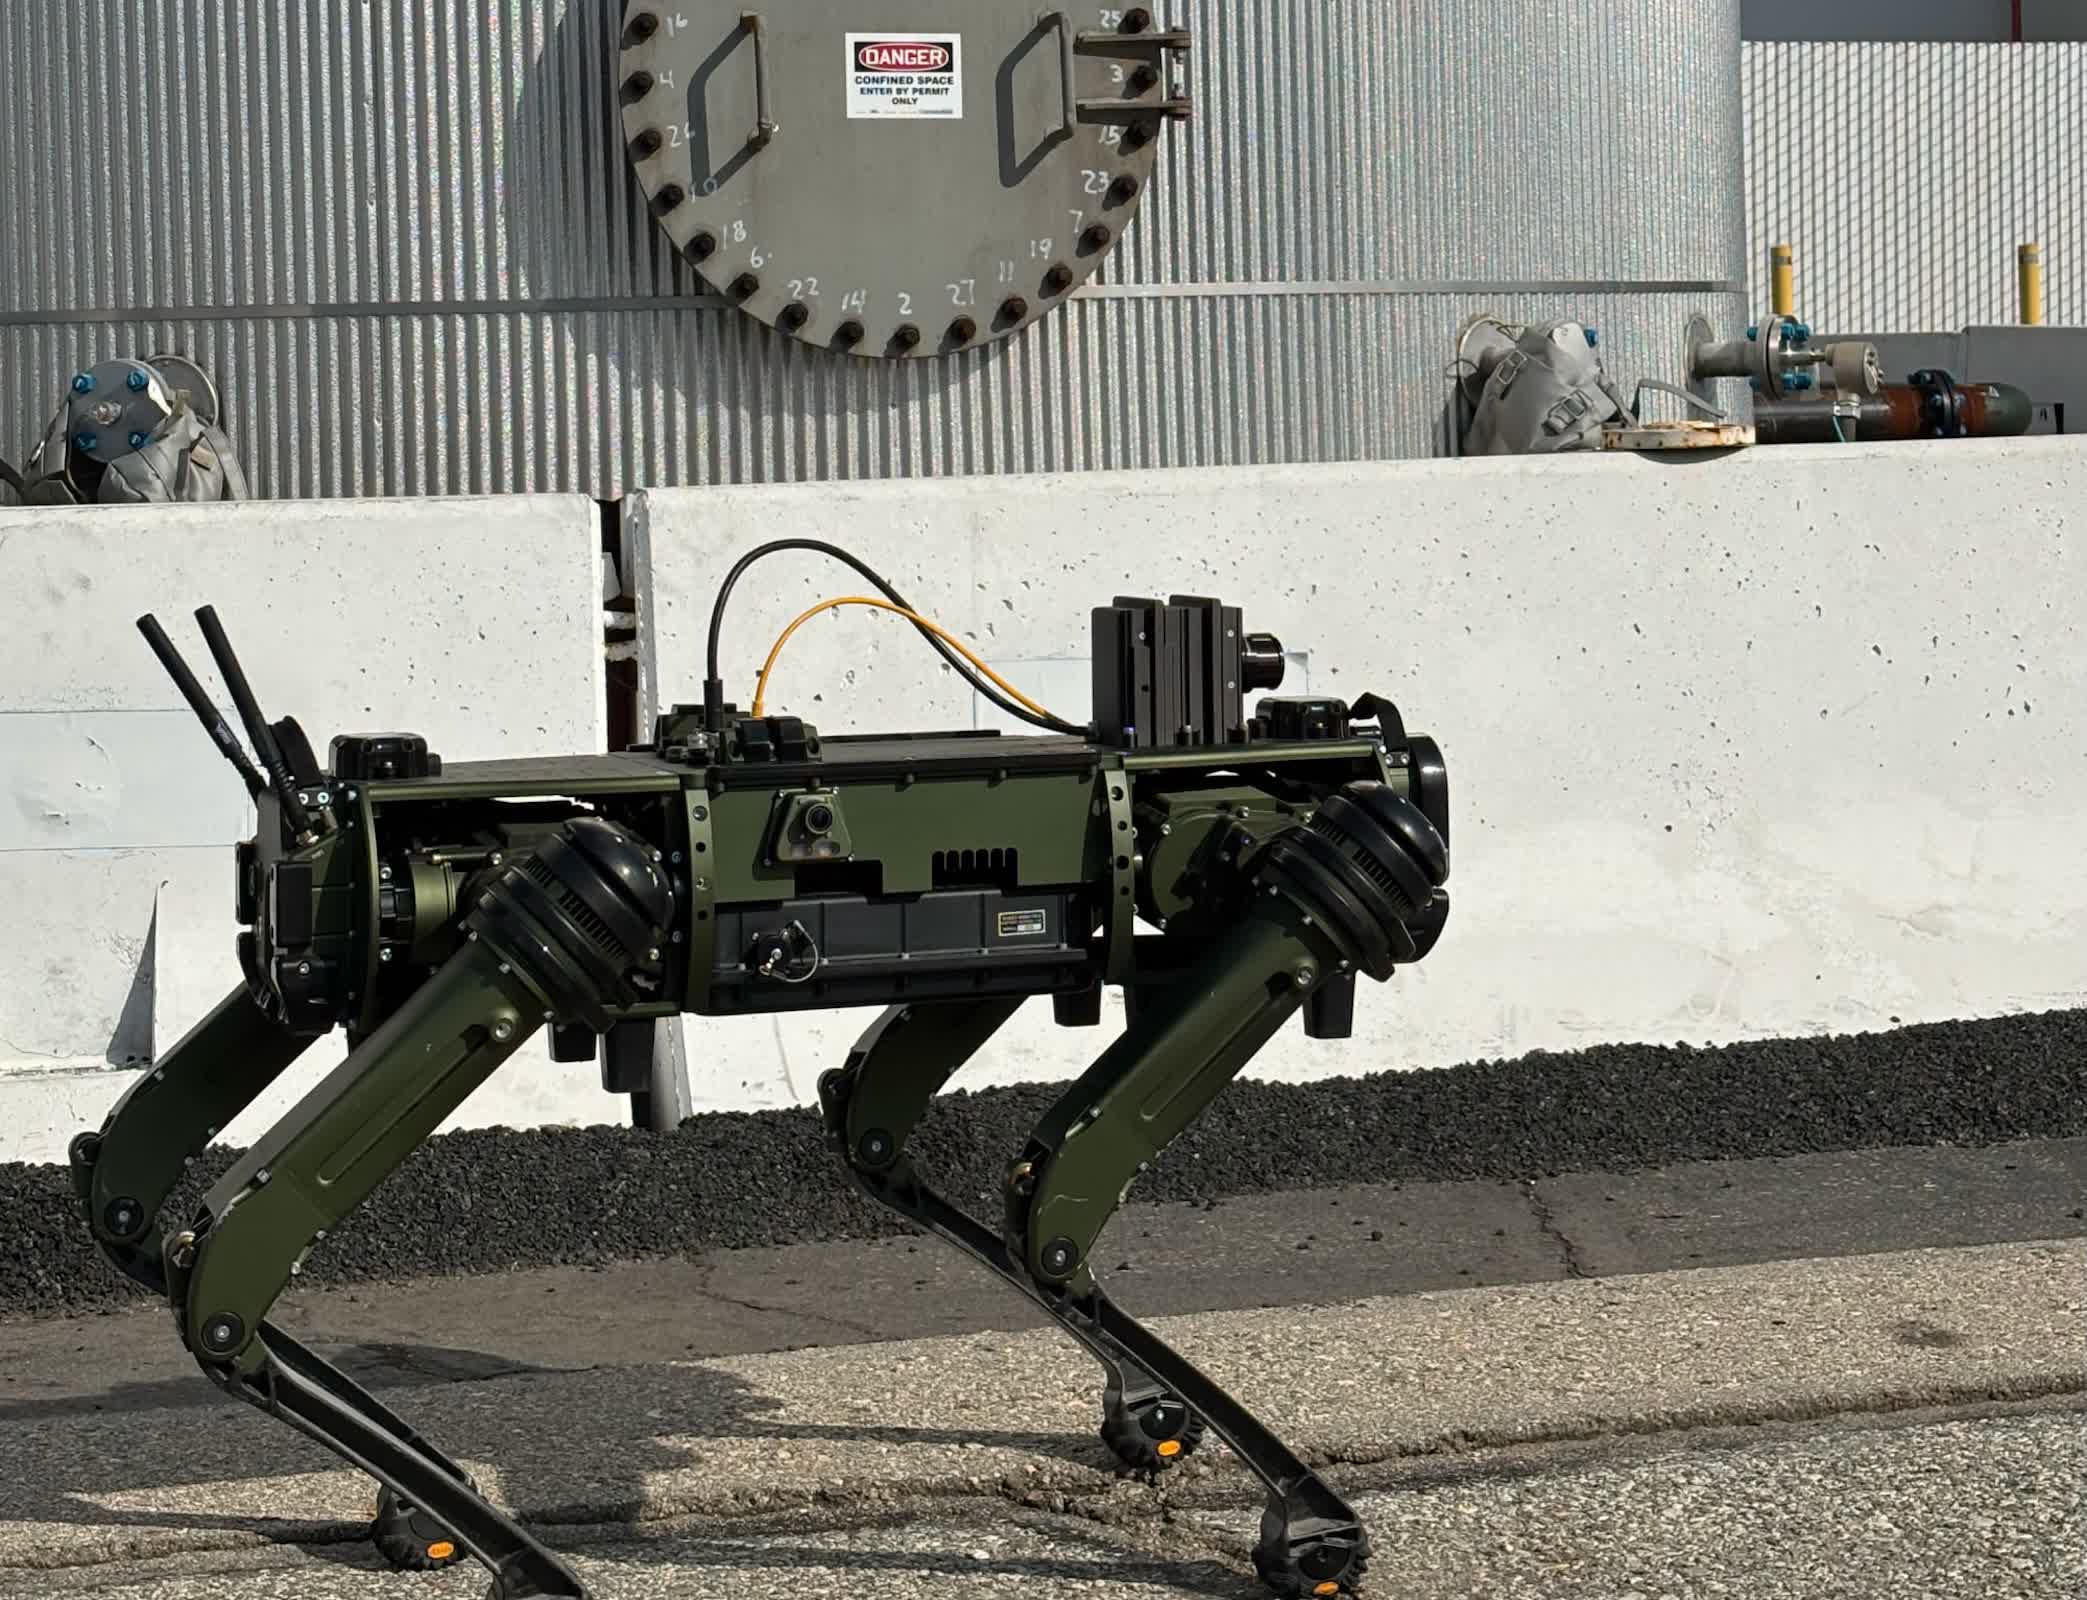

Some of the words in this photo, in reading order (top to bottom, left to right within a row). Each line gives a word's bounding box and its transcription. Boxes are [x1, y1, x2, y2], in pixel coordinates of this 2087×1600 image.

[667, 13, 688, 37] 16
[1100, 9, 1121, 28] 25
[865, 49, 942, 65] DANGER
[659, 70, 674, 88] 4
[855, 76, 913, 85] CONFINED
[917, 76, 954, 85] SPACE
[1110, 64, 1123, 83] 3
[891, 97, 918, 105] ONLY
[1098, 125, 1120, 144] 15
[1081, 170, 1109, 194] 23
[1068, 209, 1083, 233] 7
[723, 220, 747, 250] 18
[1031, 239, 1052, 260] 19
[787, 277, 819, 300] 22
[946, 279, 975, 305] 27
[842, 289, 867, 313] 14
[898, 292, 912, 315] 2
